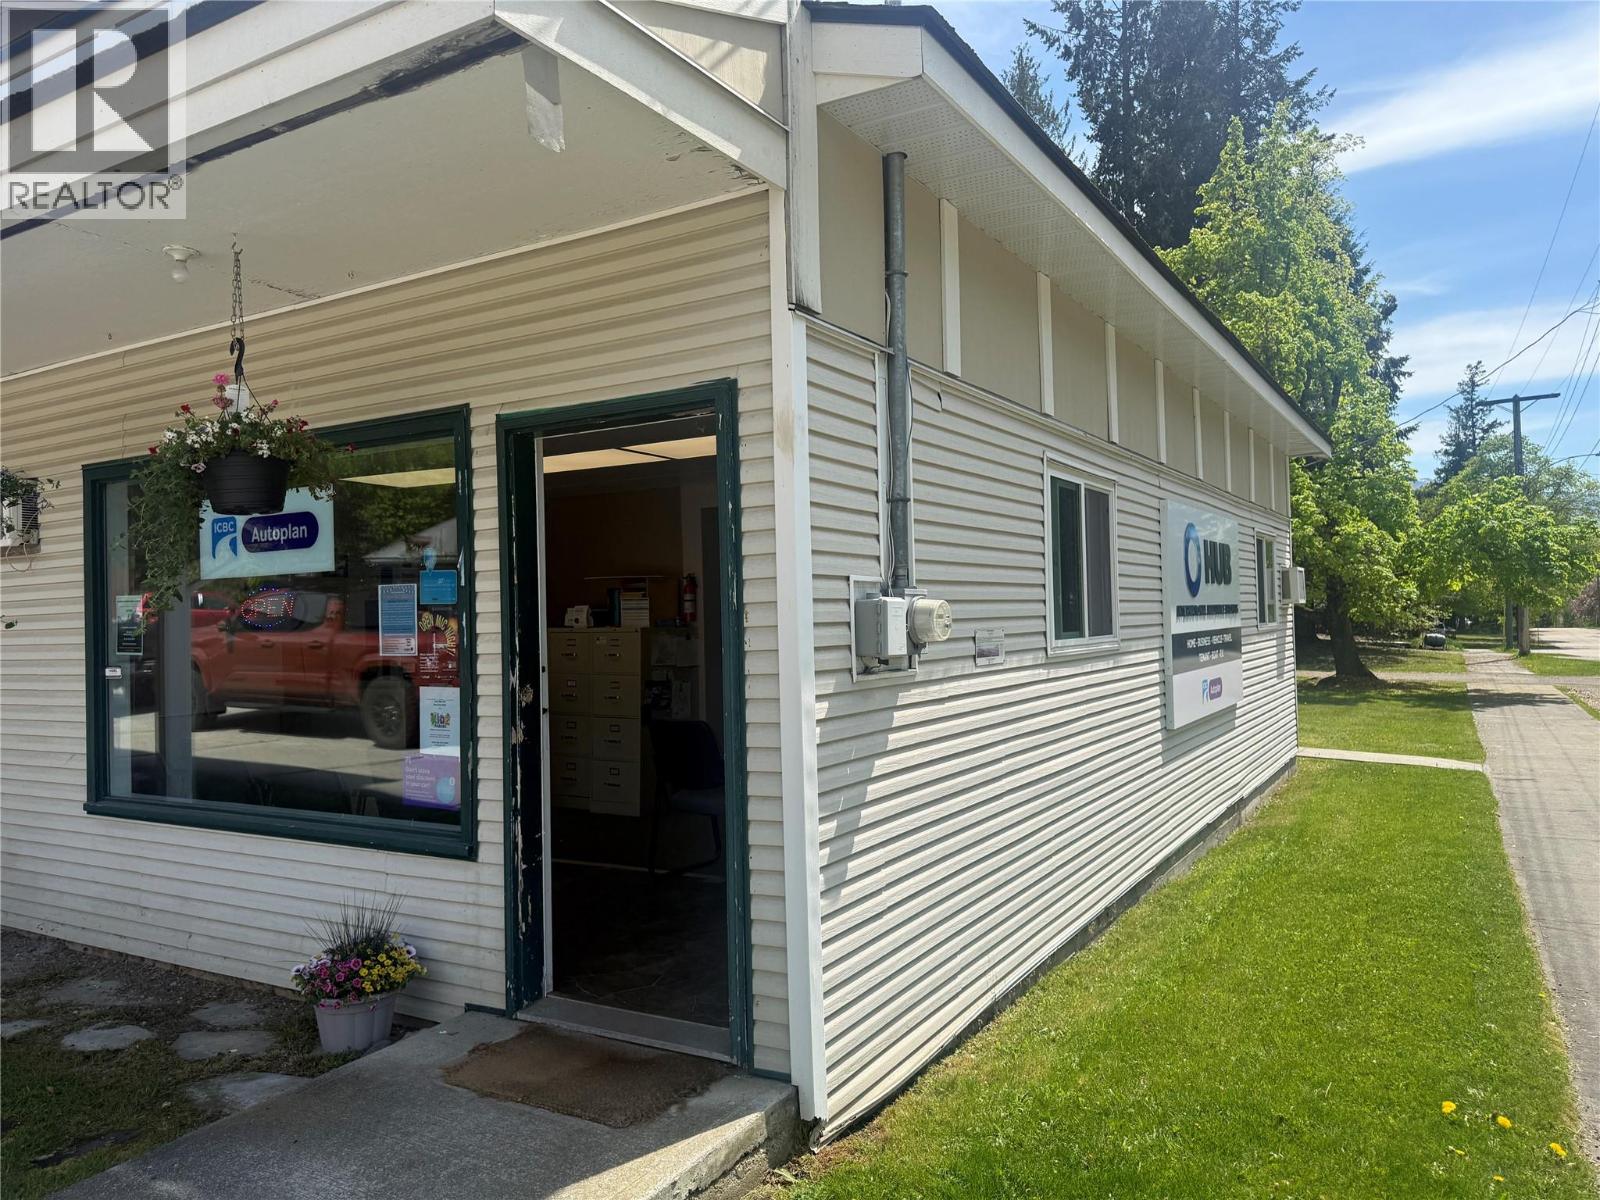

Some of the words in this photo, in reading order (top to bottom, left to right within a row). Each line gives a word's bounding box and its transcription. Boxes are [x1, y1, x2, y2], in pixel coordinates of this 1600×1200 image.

[214, 522, 234, 533] ICBC
[251, 523, 307, 544] Autoplan
[1203, 539, 1232, 586] HUB
[241, 598, 293, 618] OPEN
